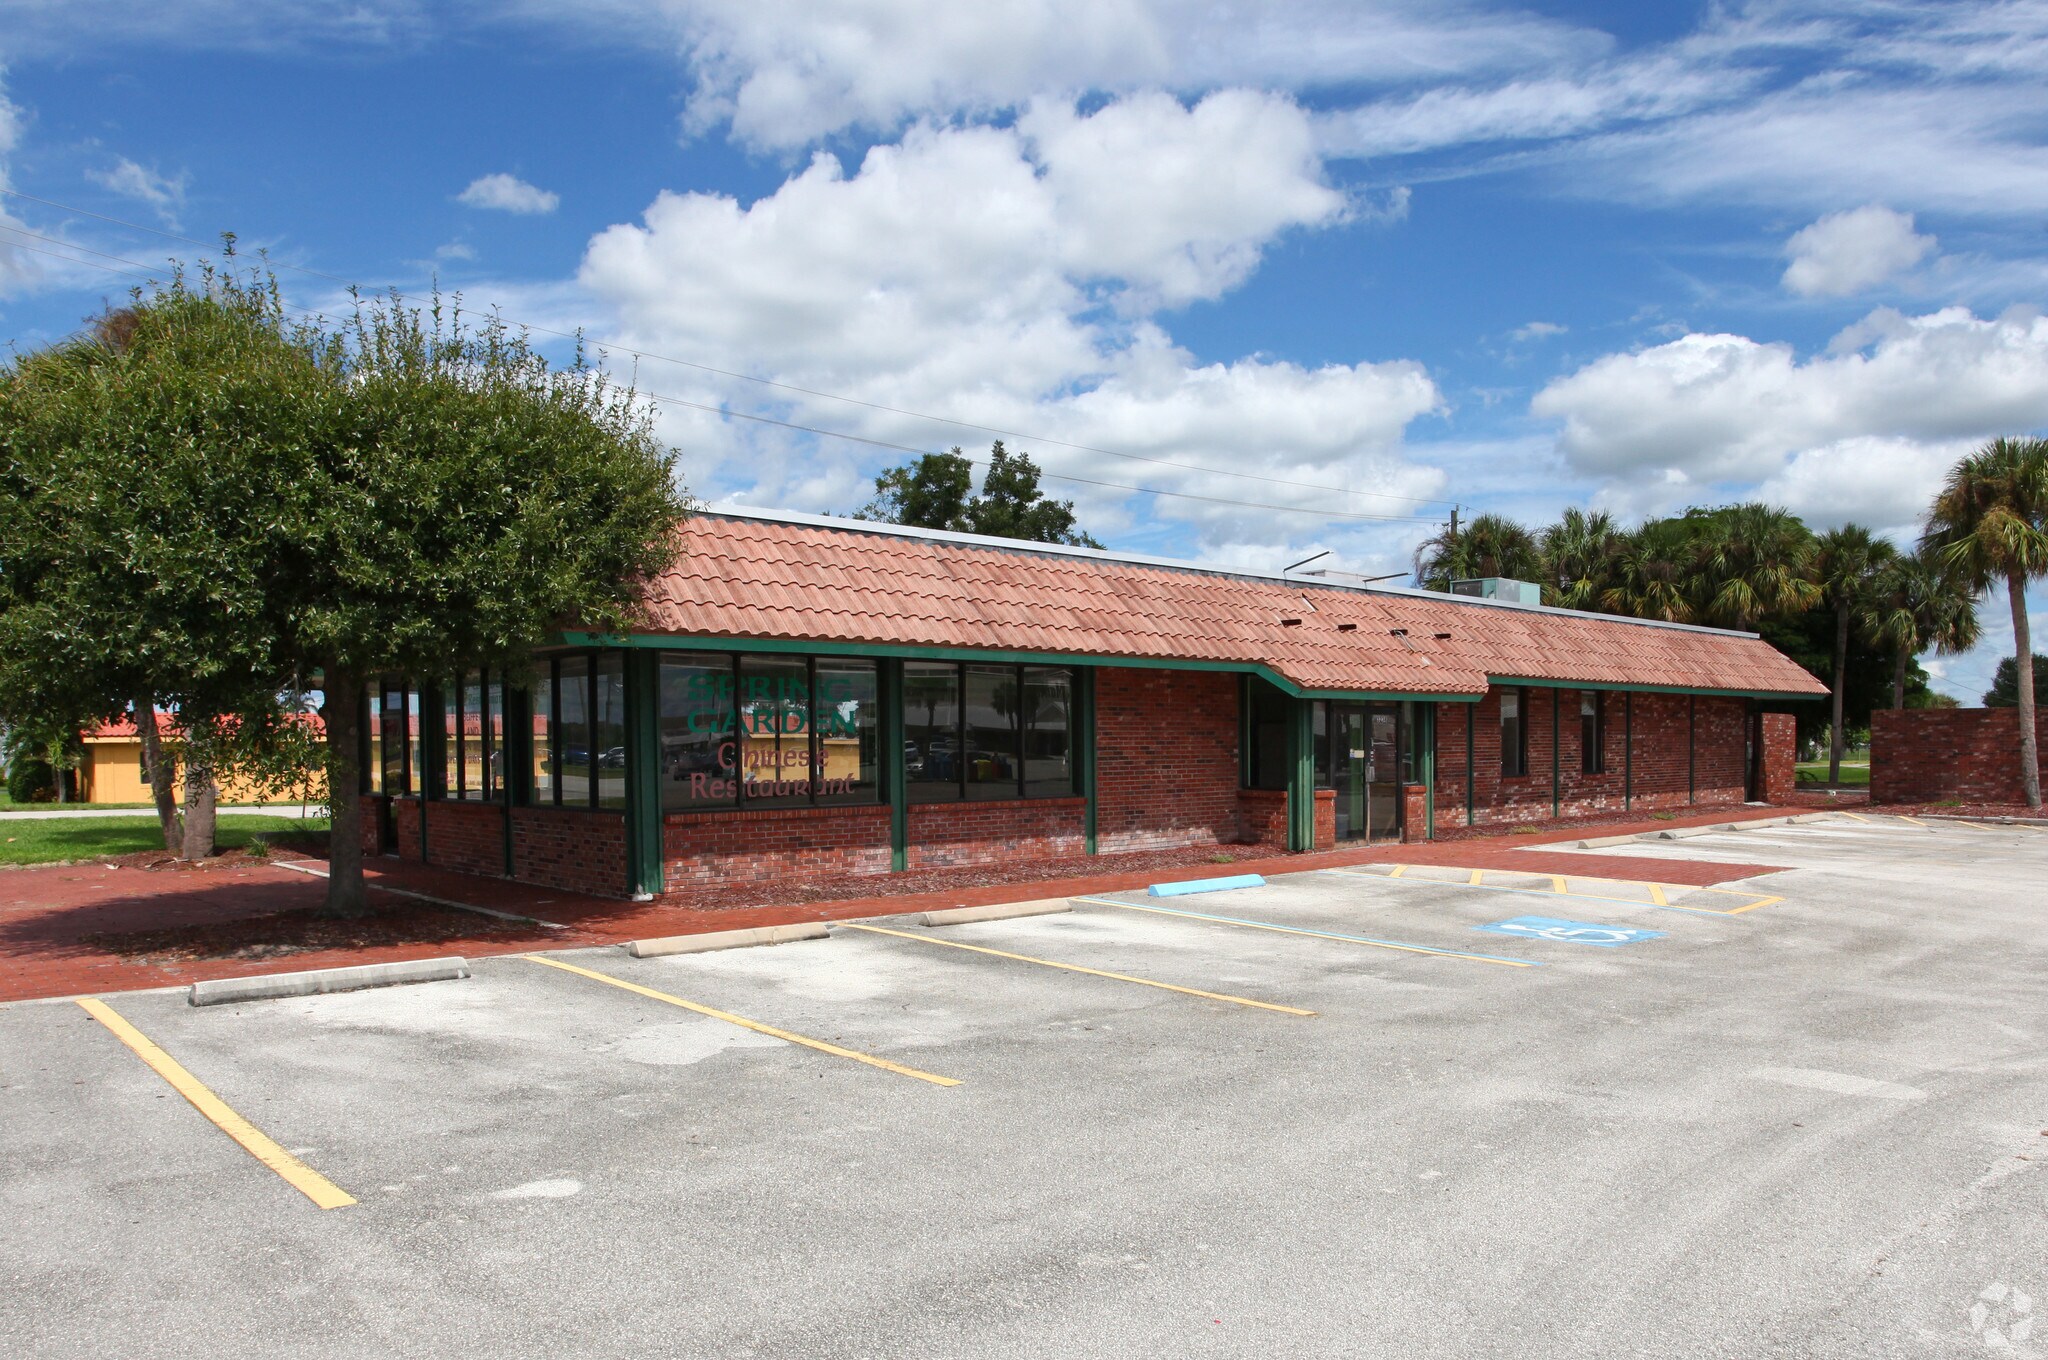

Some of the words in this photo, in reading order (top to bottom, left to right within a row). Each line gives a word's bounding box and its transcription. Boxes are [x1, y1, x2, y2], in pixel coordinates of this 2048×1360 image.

[687, 674, 852, 702] SPRING
[687, 708, 857, 734] GARDEN
[717, 741, 829, 770] Chinese
[689, 772, 856, 800] Restaurant
